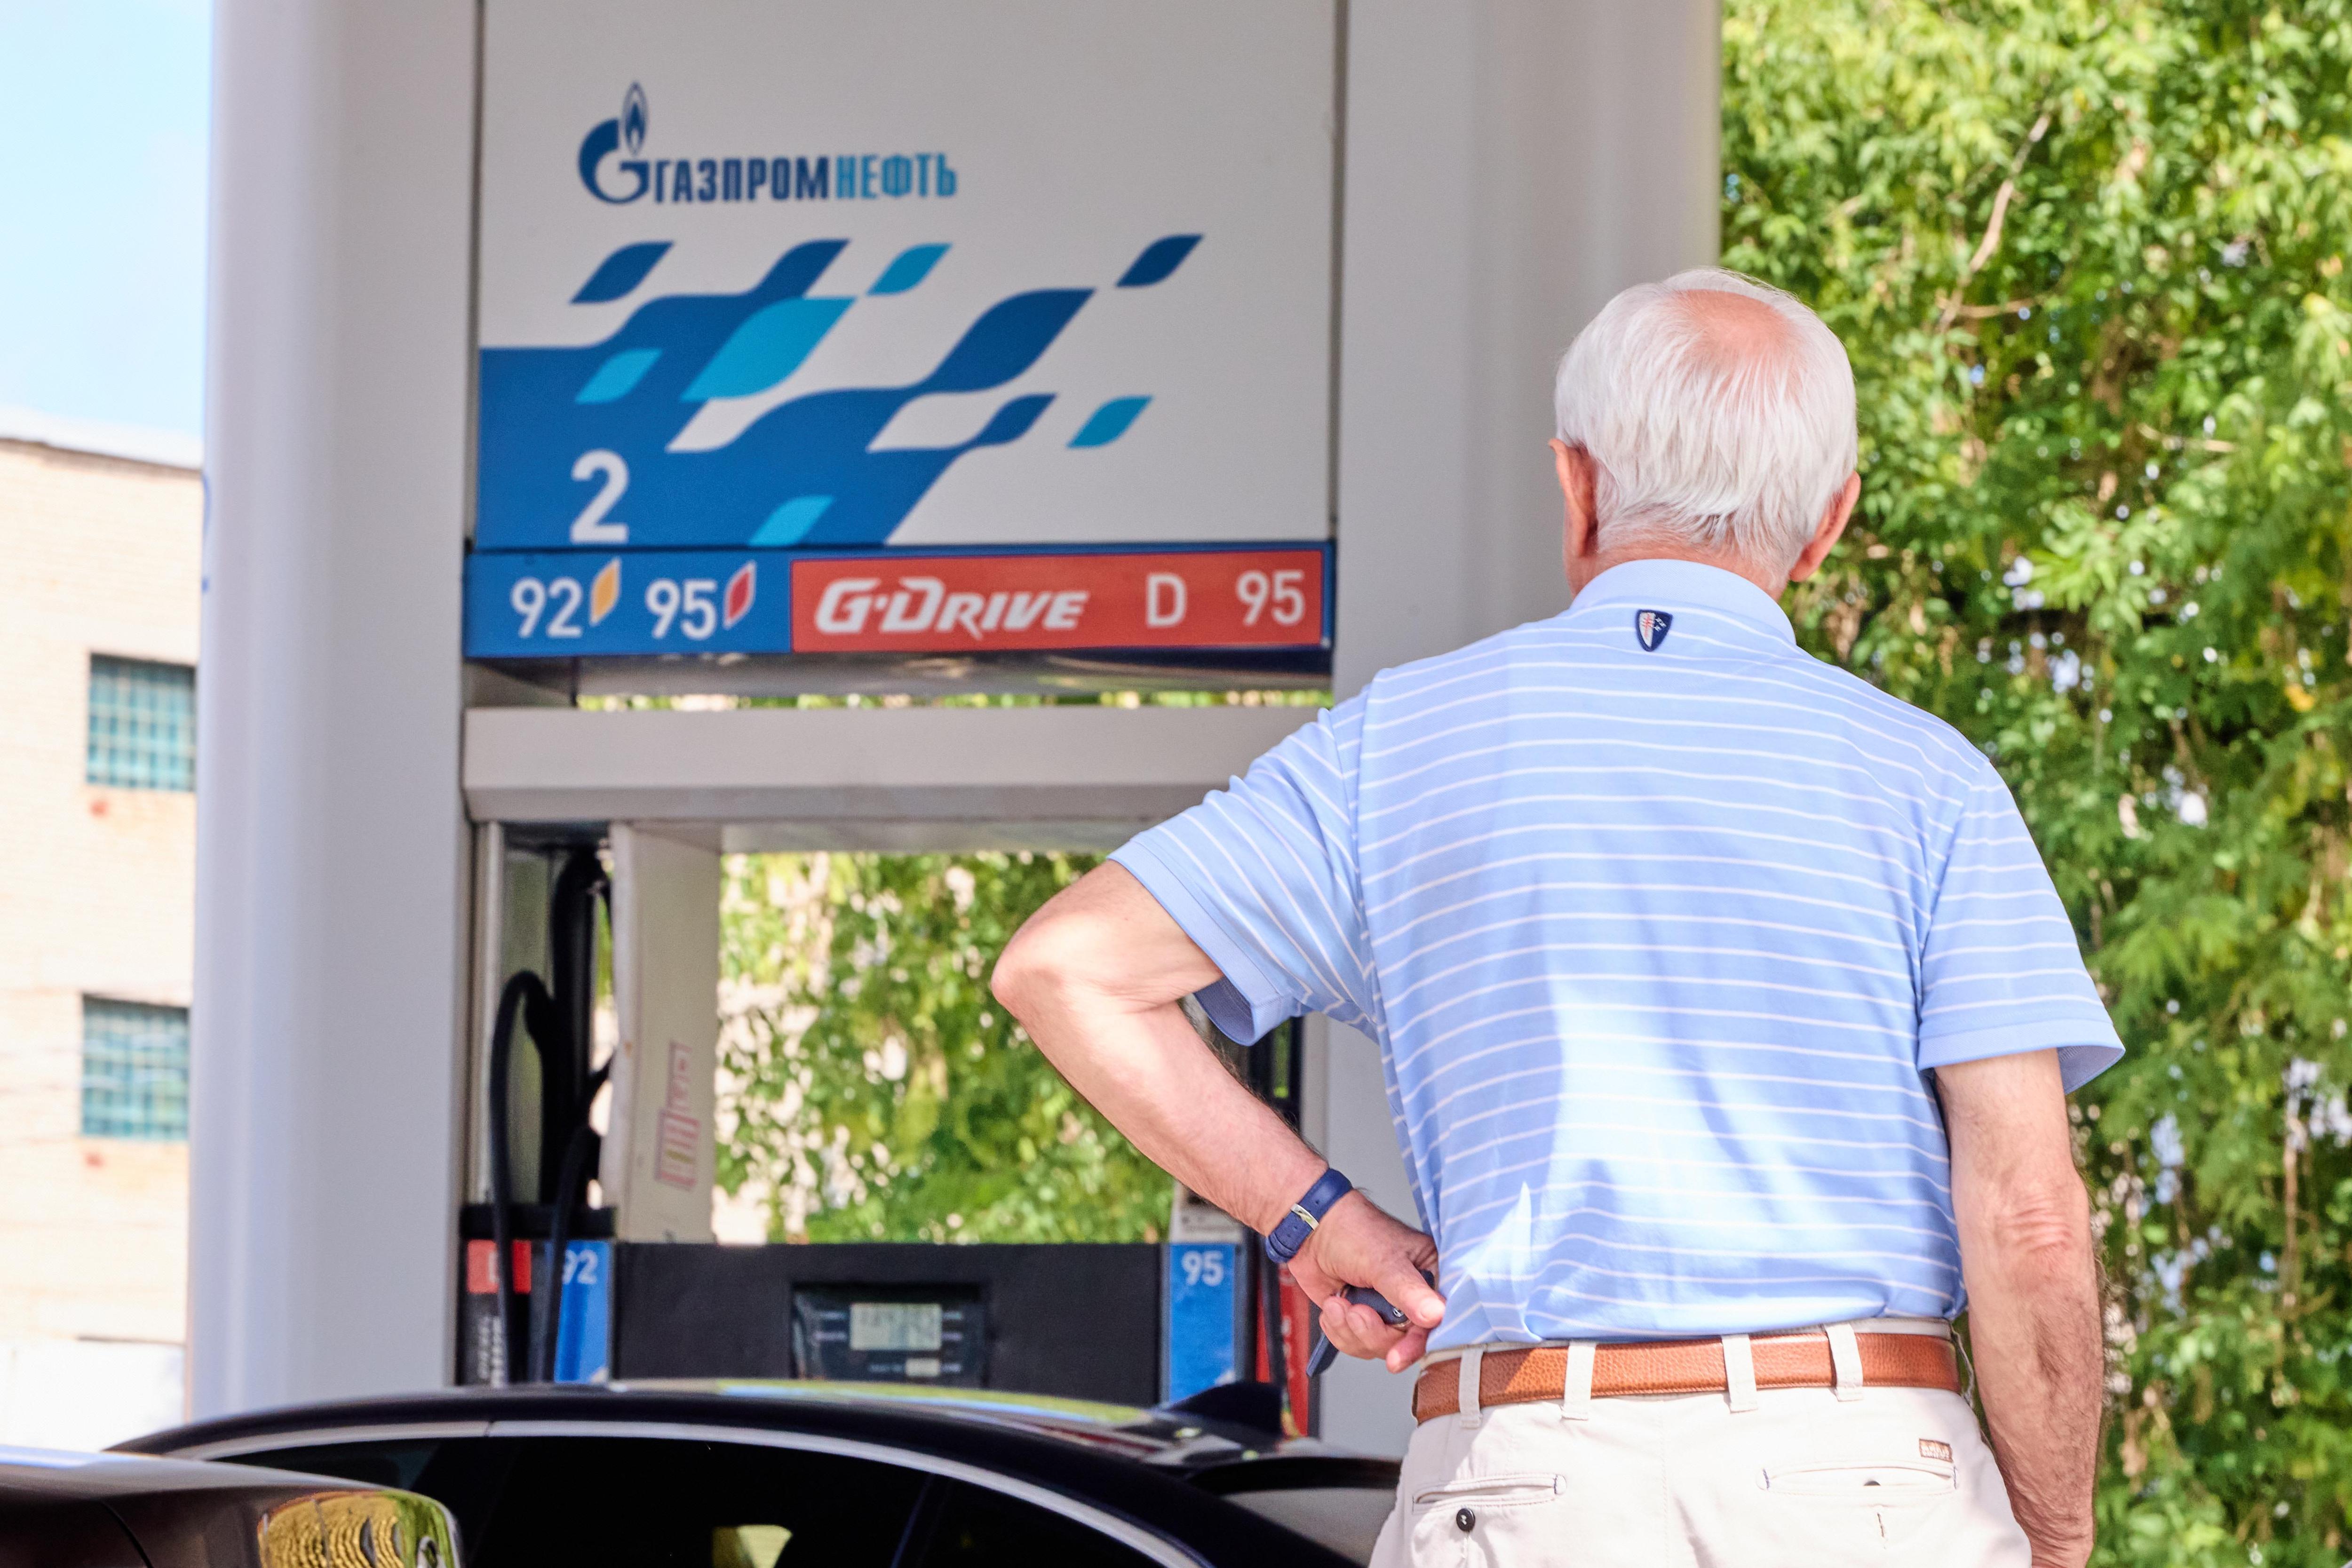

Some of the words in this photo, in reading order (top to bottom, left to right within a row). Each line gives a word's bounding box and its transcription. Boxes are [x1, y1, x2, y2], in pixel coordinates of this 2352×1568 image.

[570, 448, 629, 544] 2
[511, 577, 583, 638] 92
[645, 578, 717, 640] 95
[1146, 573, 1187, 627] D
[1237, 571, 1305, 626] 95
[1181, 1250, 1223, 1287] 95
